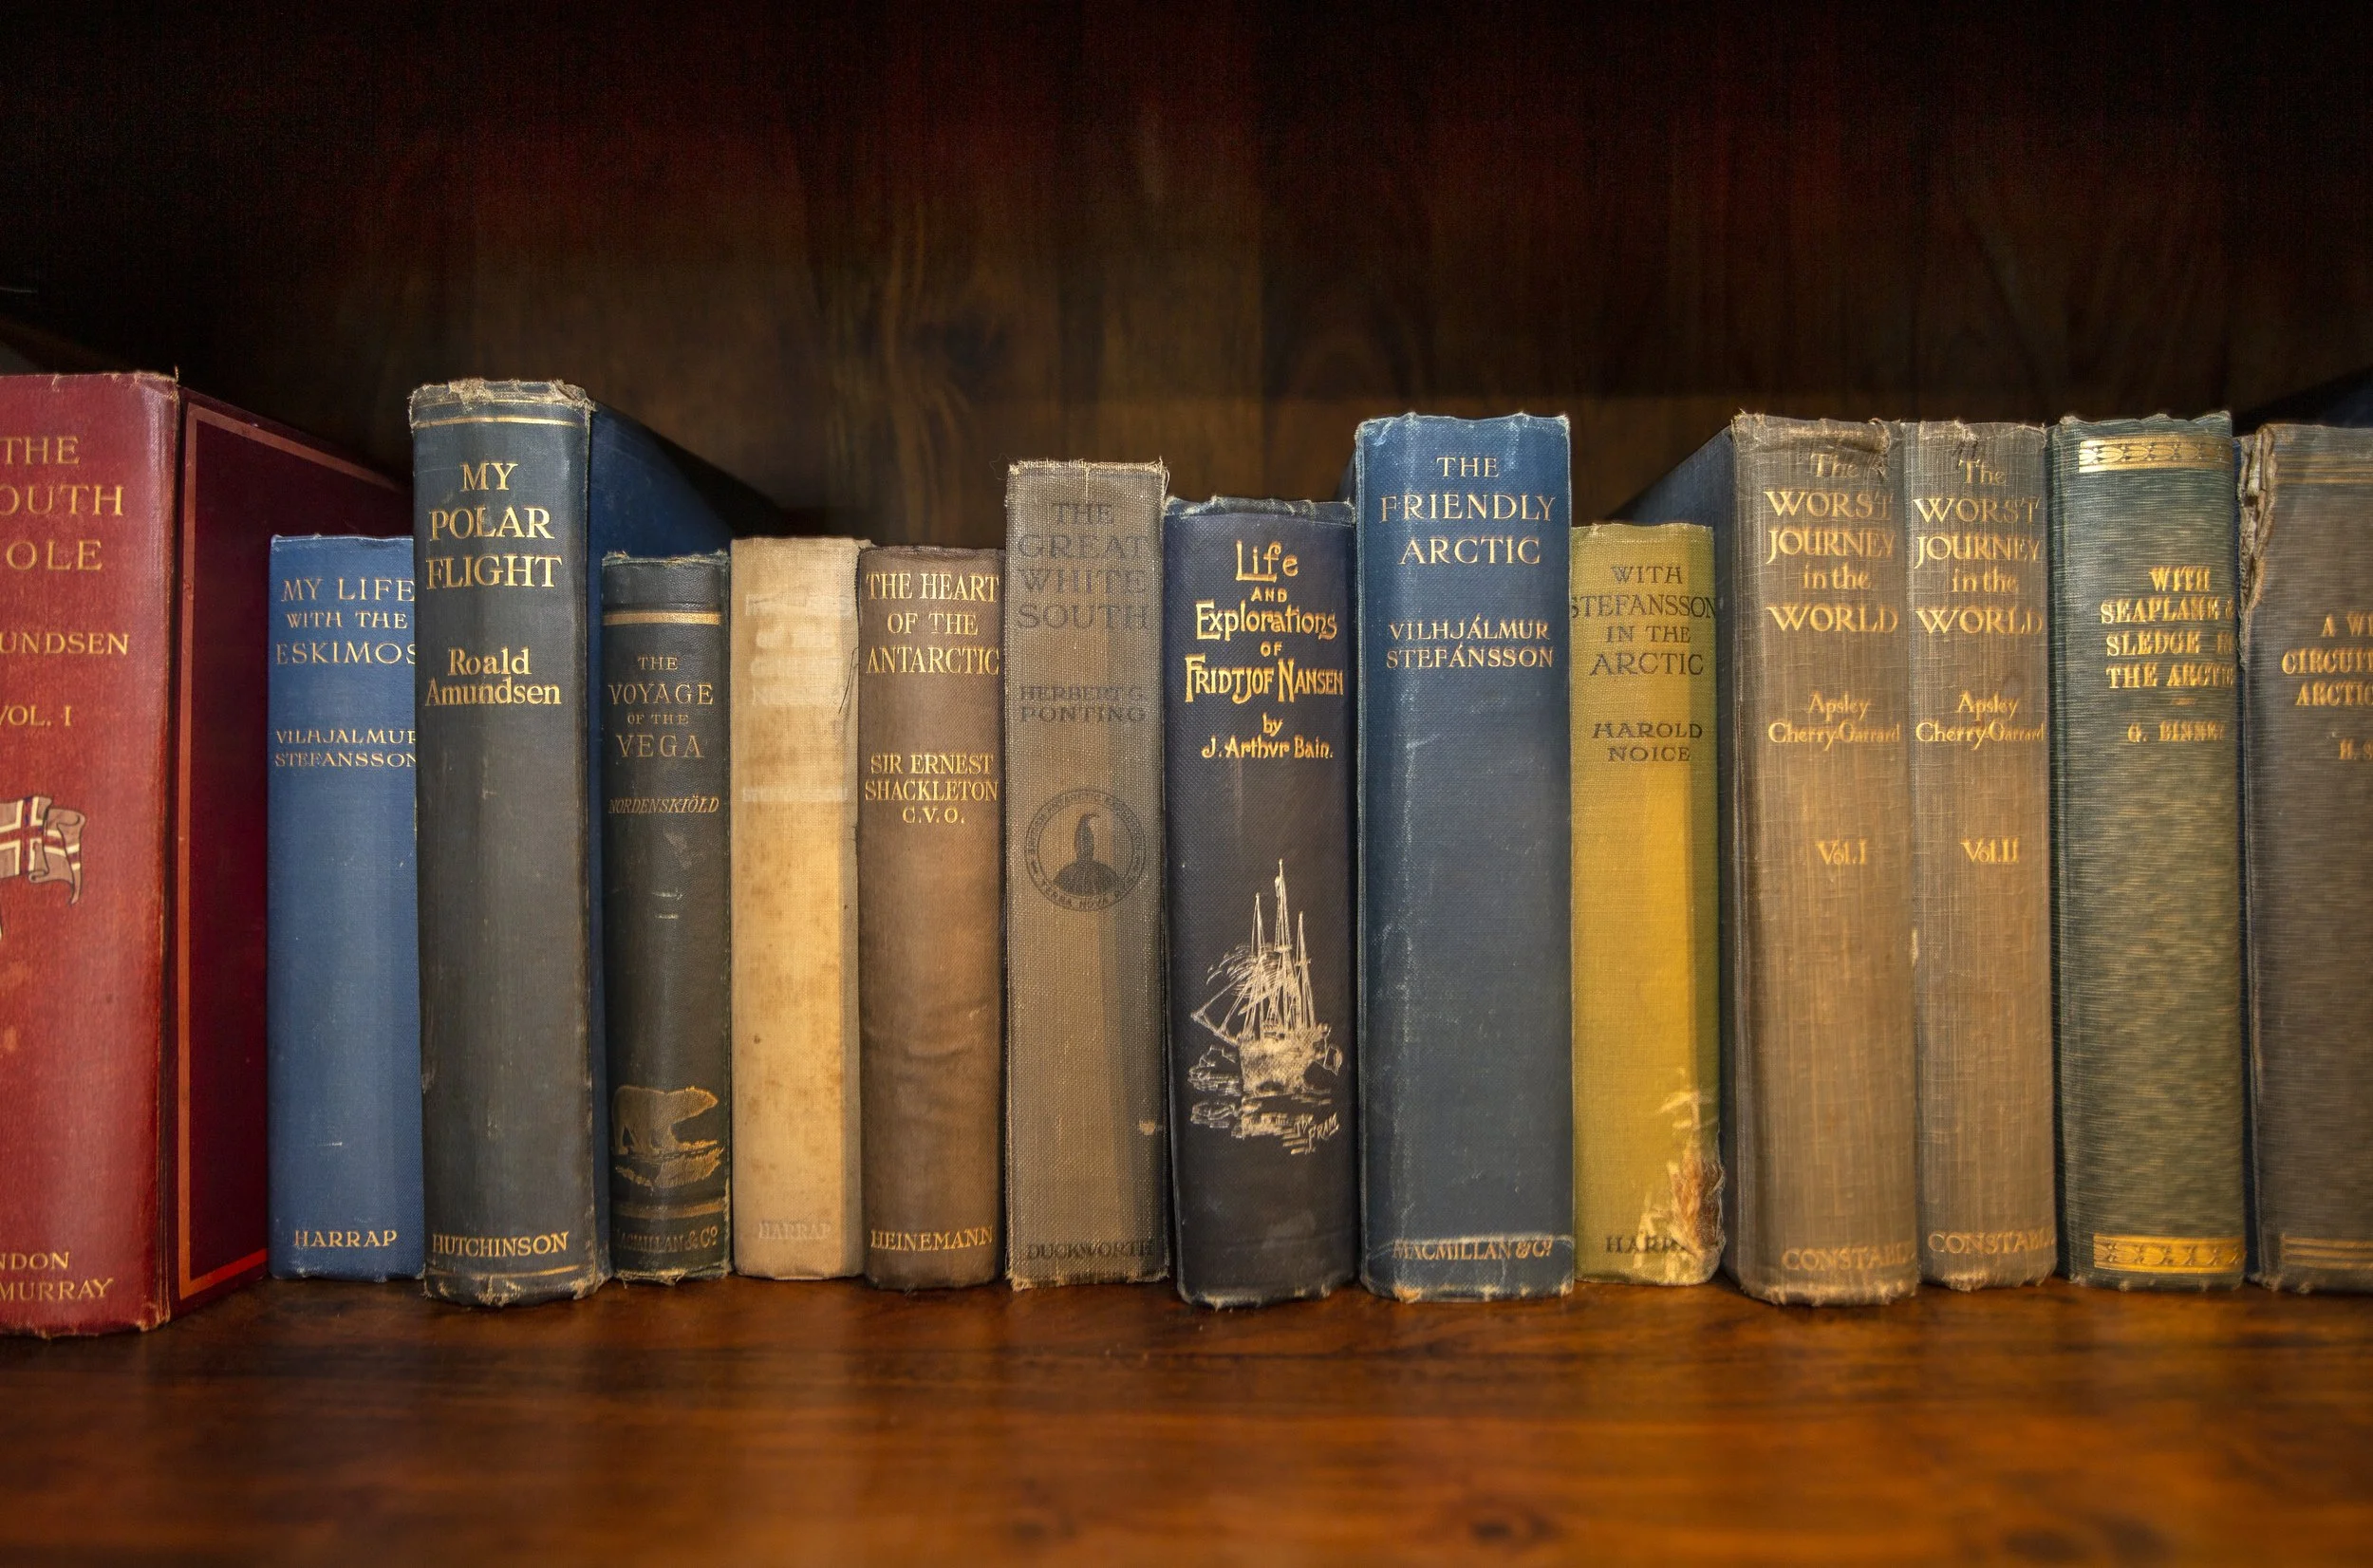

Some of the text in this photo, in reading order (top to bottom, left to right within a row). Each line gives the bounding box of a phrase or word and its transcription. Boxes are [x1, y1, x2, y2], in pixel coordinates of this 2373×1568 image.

[0, 435, 81, 465] THE
[459, 461, 519, 493] MY
[1436, 456, 1500, 478] THE
[1809, 453, 1859, 478] The
[1959, 458, 2007, 487] The
[1052, 502, 1115, 525] THE
[1380, 493, 1557, 523] FRIENDLY
[1763, 487, 1895, 521] WORST
[1913, 495, 2040, 524] WORST
[430, 506, 555, 542] POLAR
[5, 539, 103, 571] OLE
[1018, 533, 1149, 560] GREAT
[1398, 535, 1541, 566] ARCTIC
[1766, 527, 1896, 566] JOURNEY
[1914, 533, 2041, 569] JOURNEY
[426, 554, 563, 590] FLIGHT
[1235, 539, 1299, 582] Life
[866, 572, 1000, 603] THE HEART
[1019, 569, 1149, 595] WHITE
[1612, 566, 1683, 585] WITH
[1803, 564, 1872, 591] in the
[1952, 566, 2019, 594] in the
[2148, 565, 2211, 592] WITH
[280, 576, 415, 603] MY LIFE
[1250, 586, 1289, 603] AND
[287, 609, 408, 629] WITH THE
[1018, 603, 1149, 629] SOUTH
[1571, 594, 1716, 619] STEFANSSON
[1766, 603, 1899, 633] WORLD
[2100, 596, 2219, 625] SEAPLANE
[887, 612, 979, 636] OF THE
[1195, 598, 1338, 642] Explorations
[1389, 612, 1551, 641] VILHJÁLMUR
[1915, 605, 2043, 635] WORLD
[2321, 613, 2337, 637] A
[1605, 625, 1691, 644] IN THE
[2106, 630, 2202, 657] SLEDGE
[275, 641, 416, 665] ESKIMOS
[866, 646, 1000, 676] ANTARCTIC
[1260, 641, 1283, 657] OF
[1386, 644, 1554, 669] STEFÁNSSON
[2282, 647, 2373, 675] CIRCUIT
[447, 647, 532, 678] Roald
[637, 655, 679, 671] THE
[1589, 651, 1704, 677] ARCTIC
[2105, 662, 2234, 689] THE ARCTIC
[425, 678, 562, 705] Amundsen
[1185, 653, 1344, 704] FRIDTJOF NANSEN
[607, 683, 715, 705] VOYAGE
[1019, 685, 1124, 702] HERBERT
[1807, 689, 1871, 721] Apsley
[1956, 689, 2019, 720] Apsley
[2294, 681, 2373, 707] ARCTIC
[64, 704, 72, 727] I
[626, 713, 689, 725] OF THE
[1020, 705, 1147, 723] PONTING
[1261, 712, 1283, 737] by
[1591, 720, 1704, 739] HAROLD
[616, 734, 705, 758] VEGA
[1201, 735, 1222, 758] J.
[1607, 746, 1691, 762] NOICE
[274, 752, 417, 768] STEFANSSON
[869, 753, 994, 775] SIR ERNEST
[864, 779, 1000, 801] SHACKLETON
[293, 1229, 398, 1249] HARRAP
[432, 1230, 570, 1258] HUTCHINSON
[616, 1233, 683, 1254] ACMILLAN
[870, 1226, 994, 1252] HEINEMANN
[1027, 1239, 1155, 1260] DUCKWORTH
[1392, 1237, 1512, 1260] MACMILLAN
[0, 1277, 114, 1301] MURRAY
